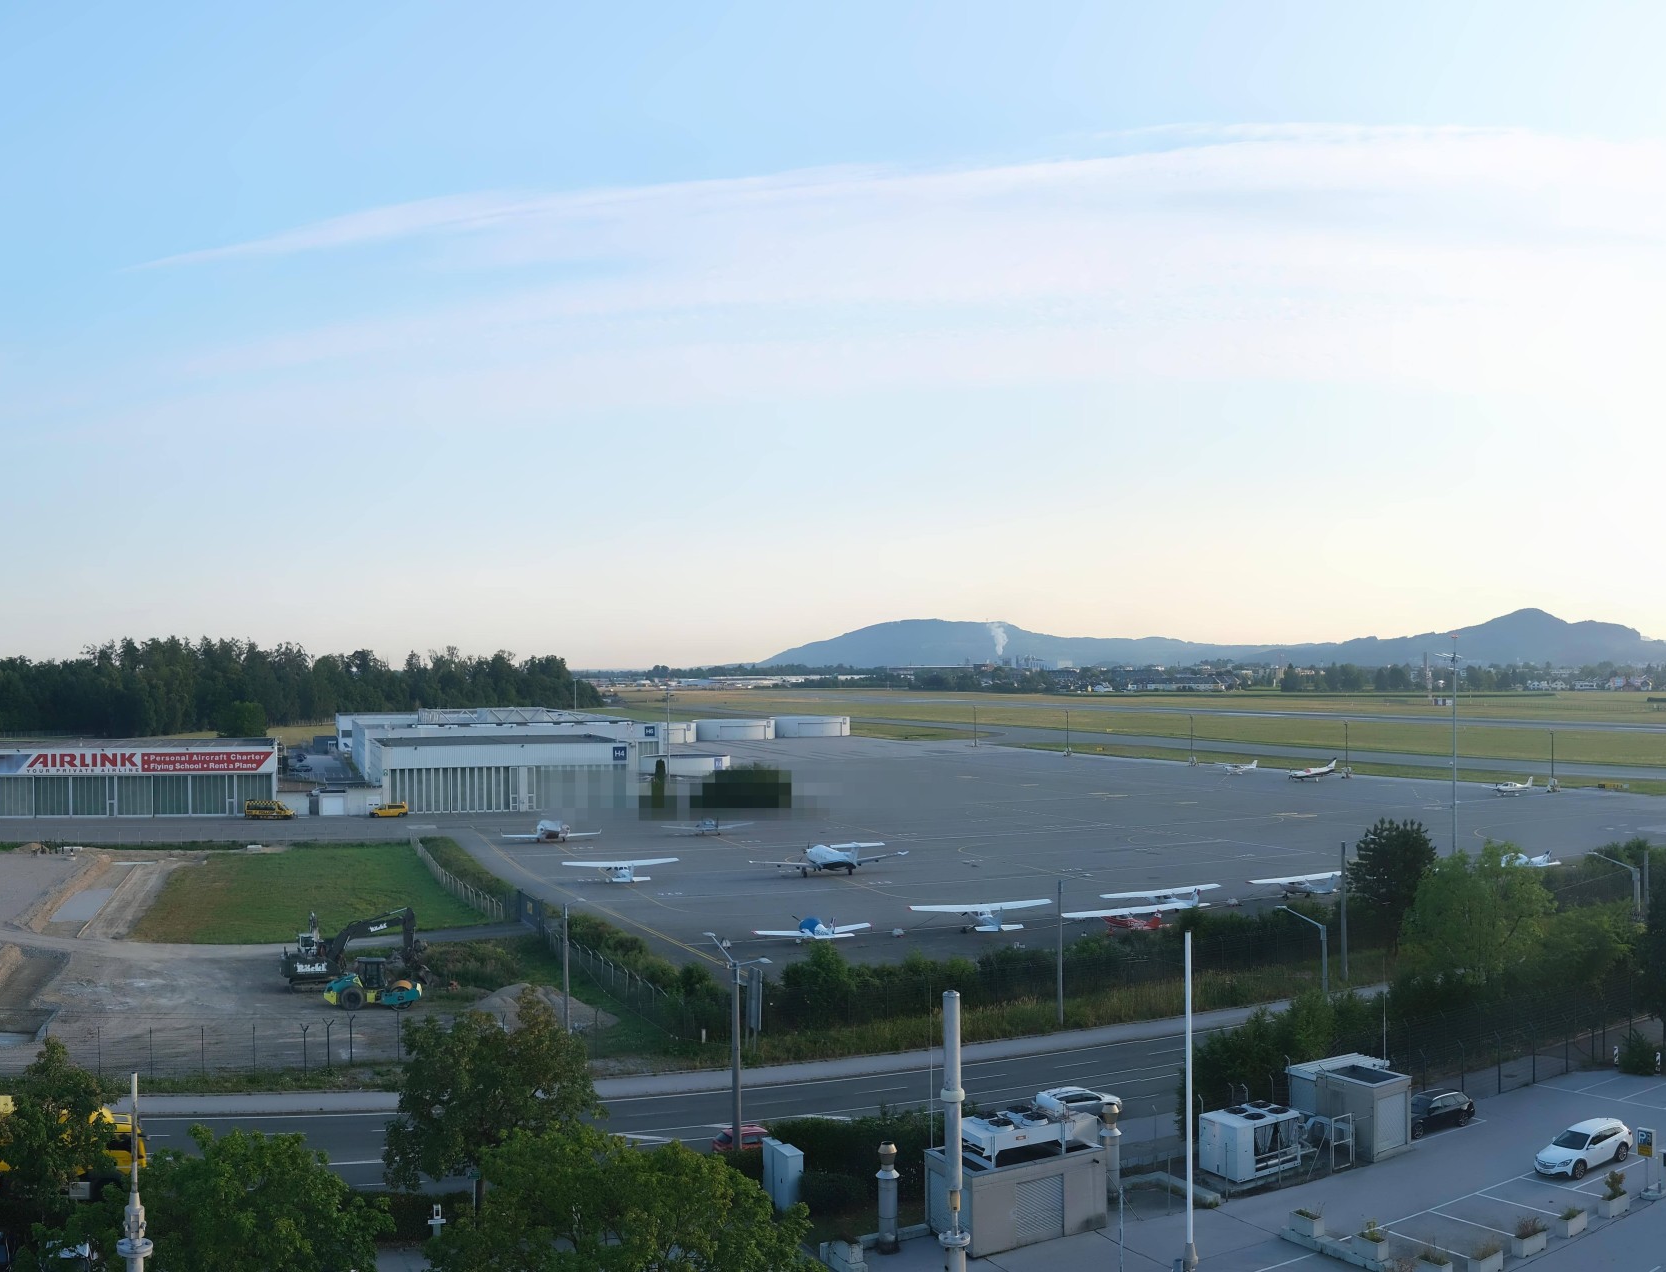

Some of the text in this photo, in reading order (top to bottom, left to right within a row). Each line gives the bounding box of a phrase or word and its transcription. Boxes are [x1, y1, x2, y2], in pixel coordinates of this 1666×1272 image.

[26, 753, 139, 768] AIRLINK
[150, 753, 265, 762] Personal Aircraft Charter
[150, 762, 173, 771] Flying
[175, 762, 202, 770] School
